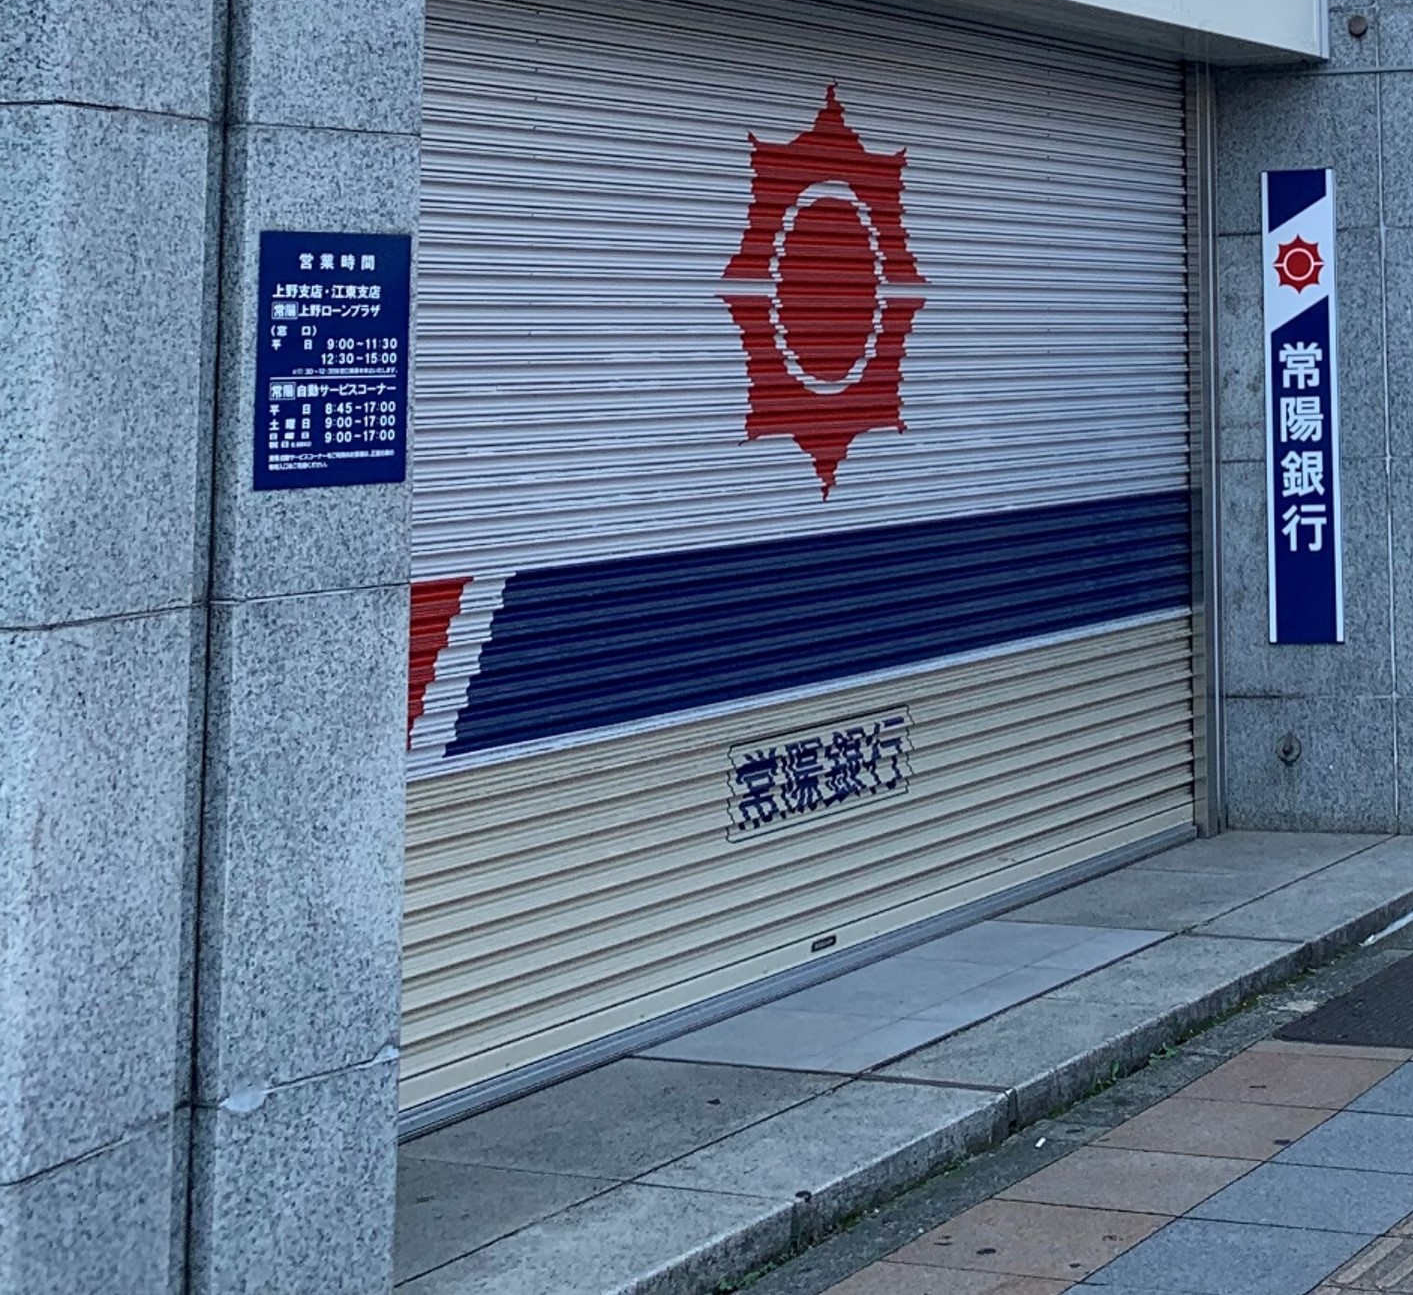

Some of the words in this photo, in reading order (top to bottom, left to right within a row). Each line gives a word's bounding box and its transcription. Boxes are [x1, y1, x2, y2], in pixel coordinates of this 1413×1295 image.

[299, 253, 375, 271] 営業時間
[1278, 342, 1327, 552] 常陽銀行
[736, 716, 905, 830] 常陽銀行
